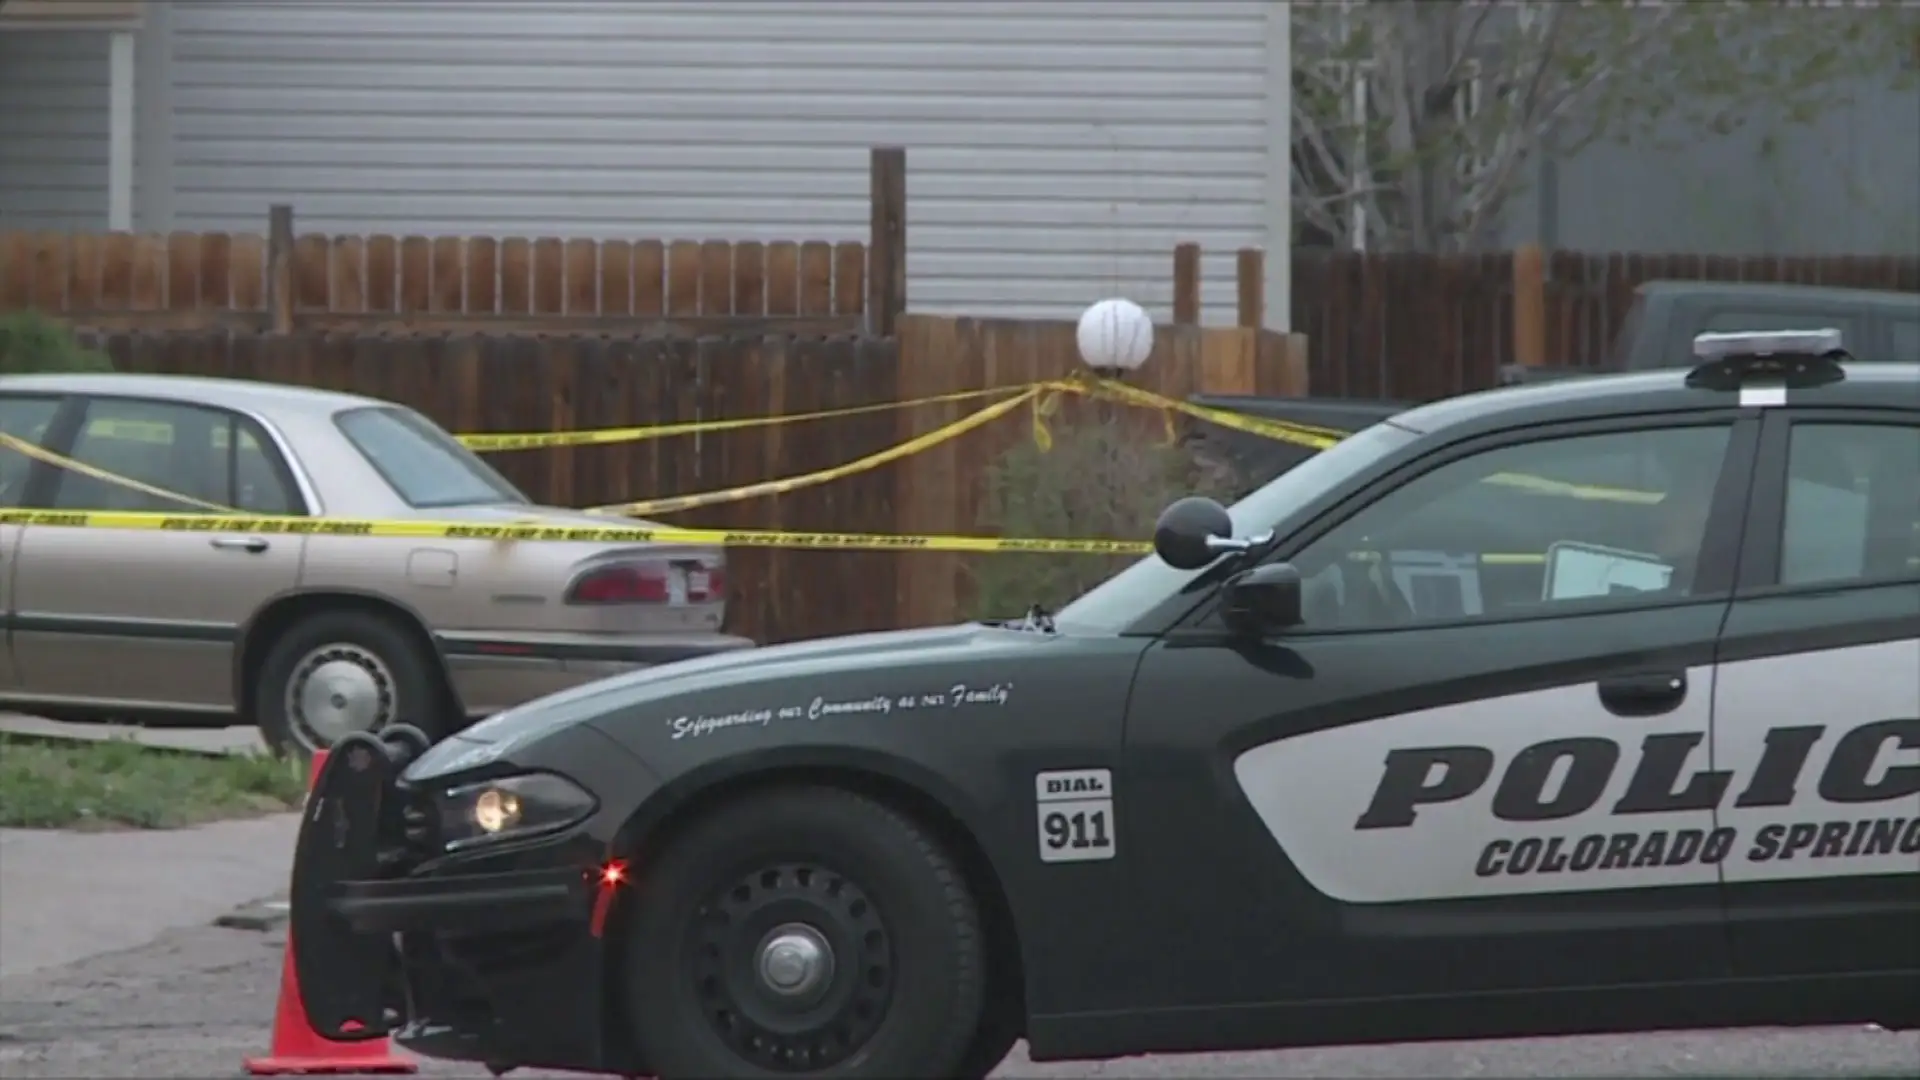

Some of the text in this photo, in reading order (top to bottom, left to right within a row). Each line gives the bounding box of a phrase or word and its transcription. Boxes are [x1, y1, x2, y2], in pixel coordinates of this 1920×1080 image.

[160, 518, 373, 535] POLICE LINE DO NOT CROSS
[445, 527, 654, 543] POLICE LINE DO NOT CROSS
[724, 533, 778, 544] POLICE
[777, 706, 804, 720] our
[808, 696, 892, 721] Community
[898, 696, 916, 709] as
[921, 694, 945, 708] our
[1046, 777, 1104, 793] DIAL
[1044, 810, 1110, 850] 911
[1475, 826, 1737, 877] COLORADO
